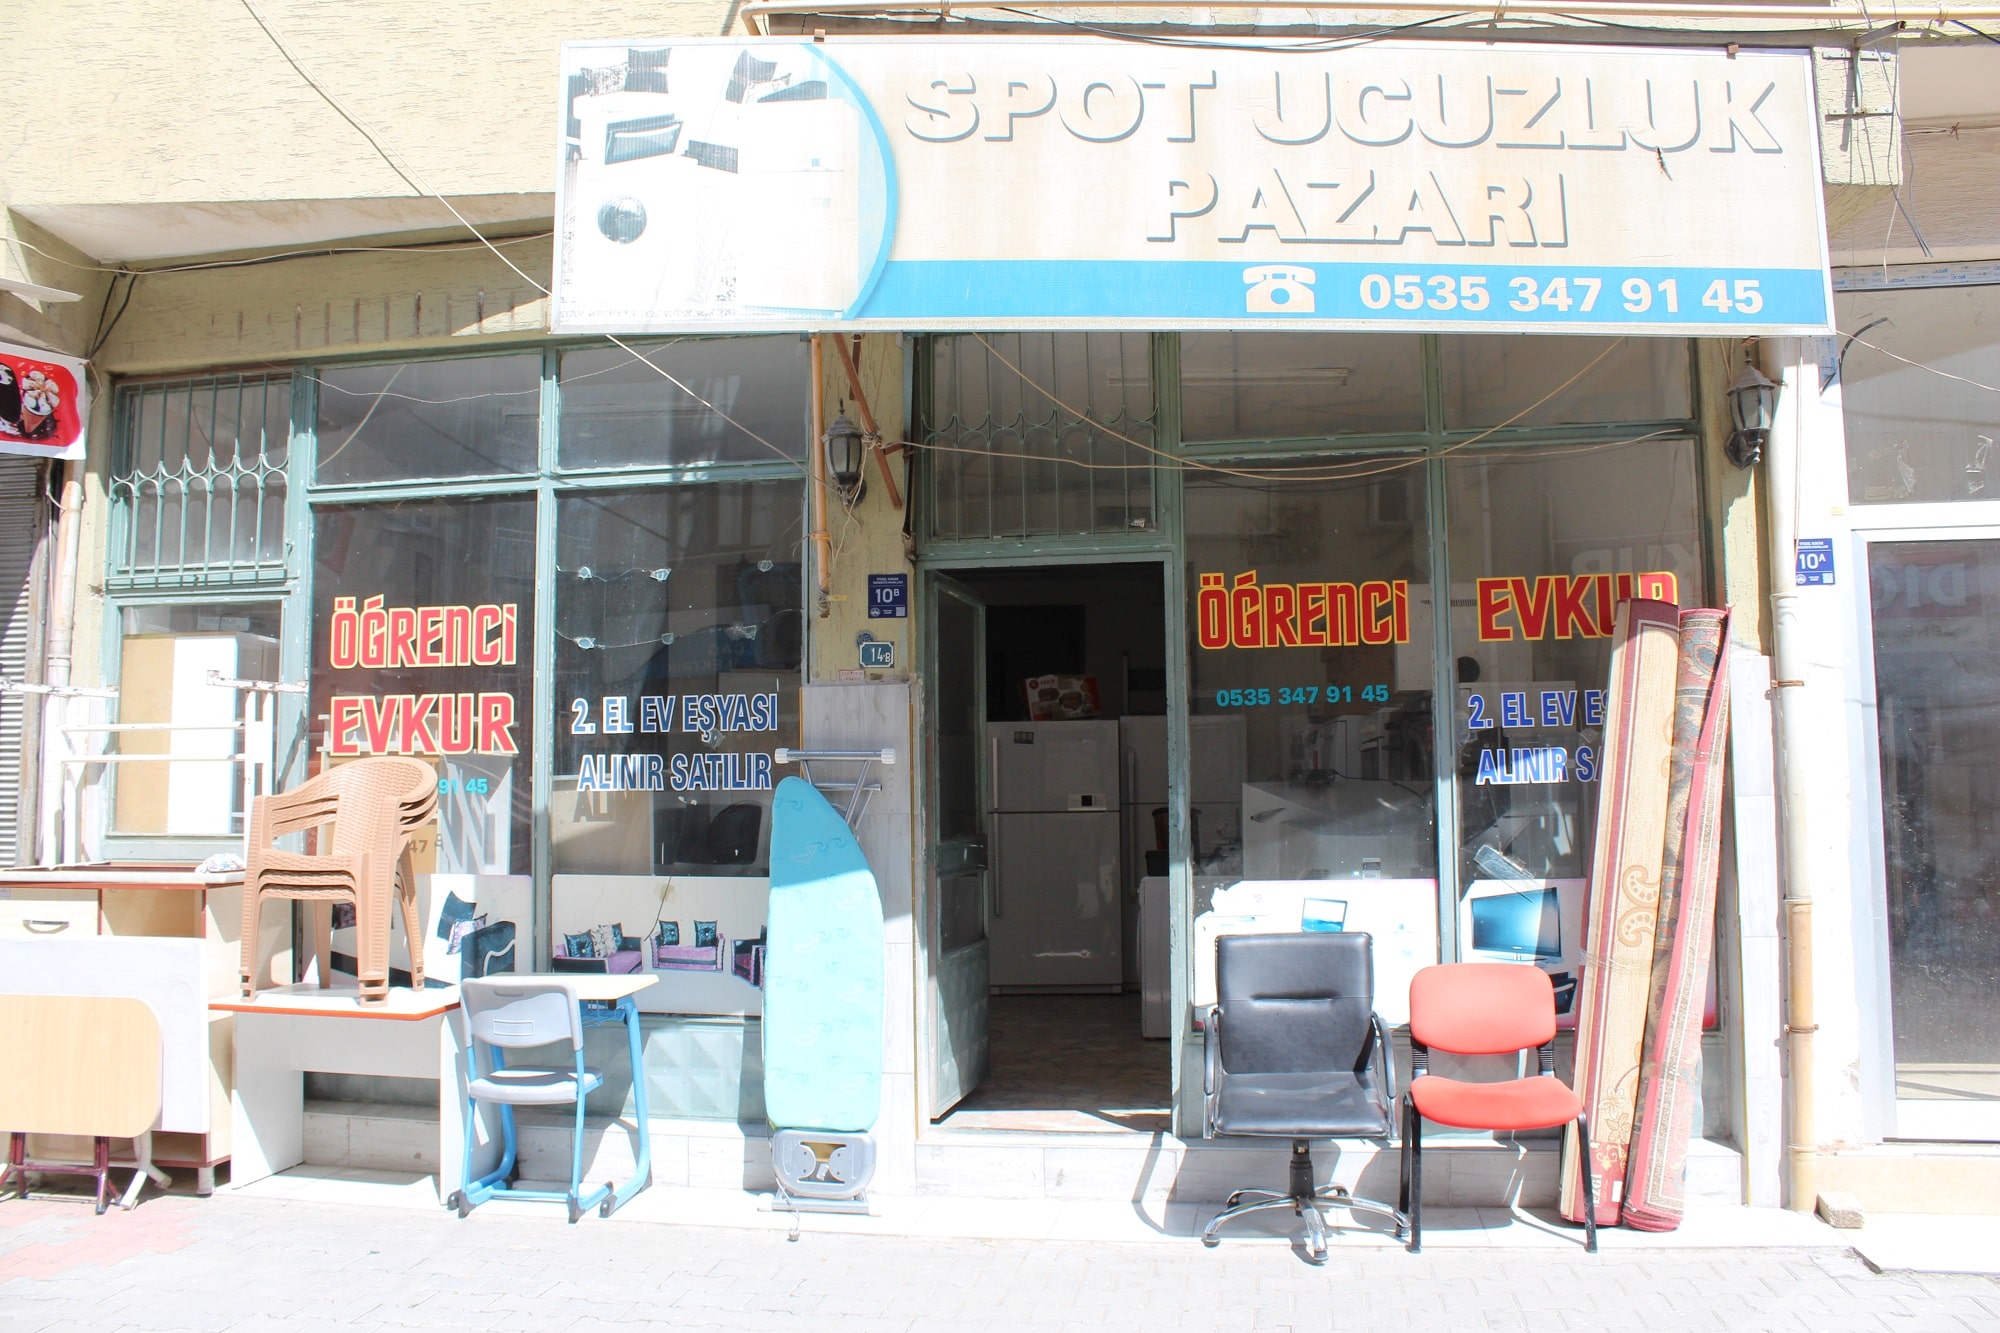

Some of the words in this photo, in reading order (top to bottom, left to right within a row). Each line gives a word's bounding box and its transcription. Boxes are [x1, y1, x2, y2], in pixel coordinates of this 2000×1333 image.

[903, 69, 1216, 142] SPOT
[1250, 71, 1784, 154] UCUZLUK
[1146, 167, 1568, 248] PAZARI
[1359, 274, 1490, 311] 0535
[1508, 277, 1602, 312] 347
[1621, 278, 1679, 313] 91
[1701, 279, 1763, 314] 45
[875, 588, 900, 603] 10B
[1216, 688, 1271, 707] 0535
[1278, 686, 1319, 705] 347
[1326, 685, 1352, 703] 91
[1361, 684, 1389, 702] 45
[1468, 694, 1493, 729] 2.
[1501, 691, 1534, 728] EL
[1541, 690, 1577, 727] EV
[330, 692, 519, 756] EVKUR
[571, 698, 596, 734] 2.
[602, 696, 634, 733] EL
[640, 695, 676, 733] EV
[682, 693, 778, 742] EŞYASI
[576, 754, 664, 791] ALINIR
[670, 752, 772, 790] SATILIR
[1475, 746, 1569, 785] ALINIR
[438, 778, 458, 794] 91
[465, 778, 488, 794] 45
